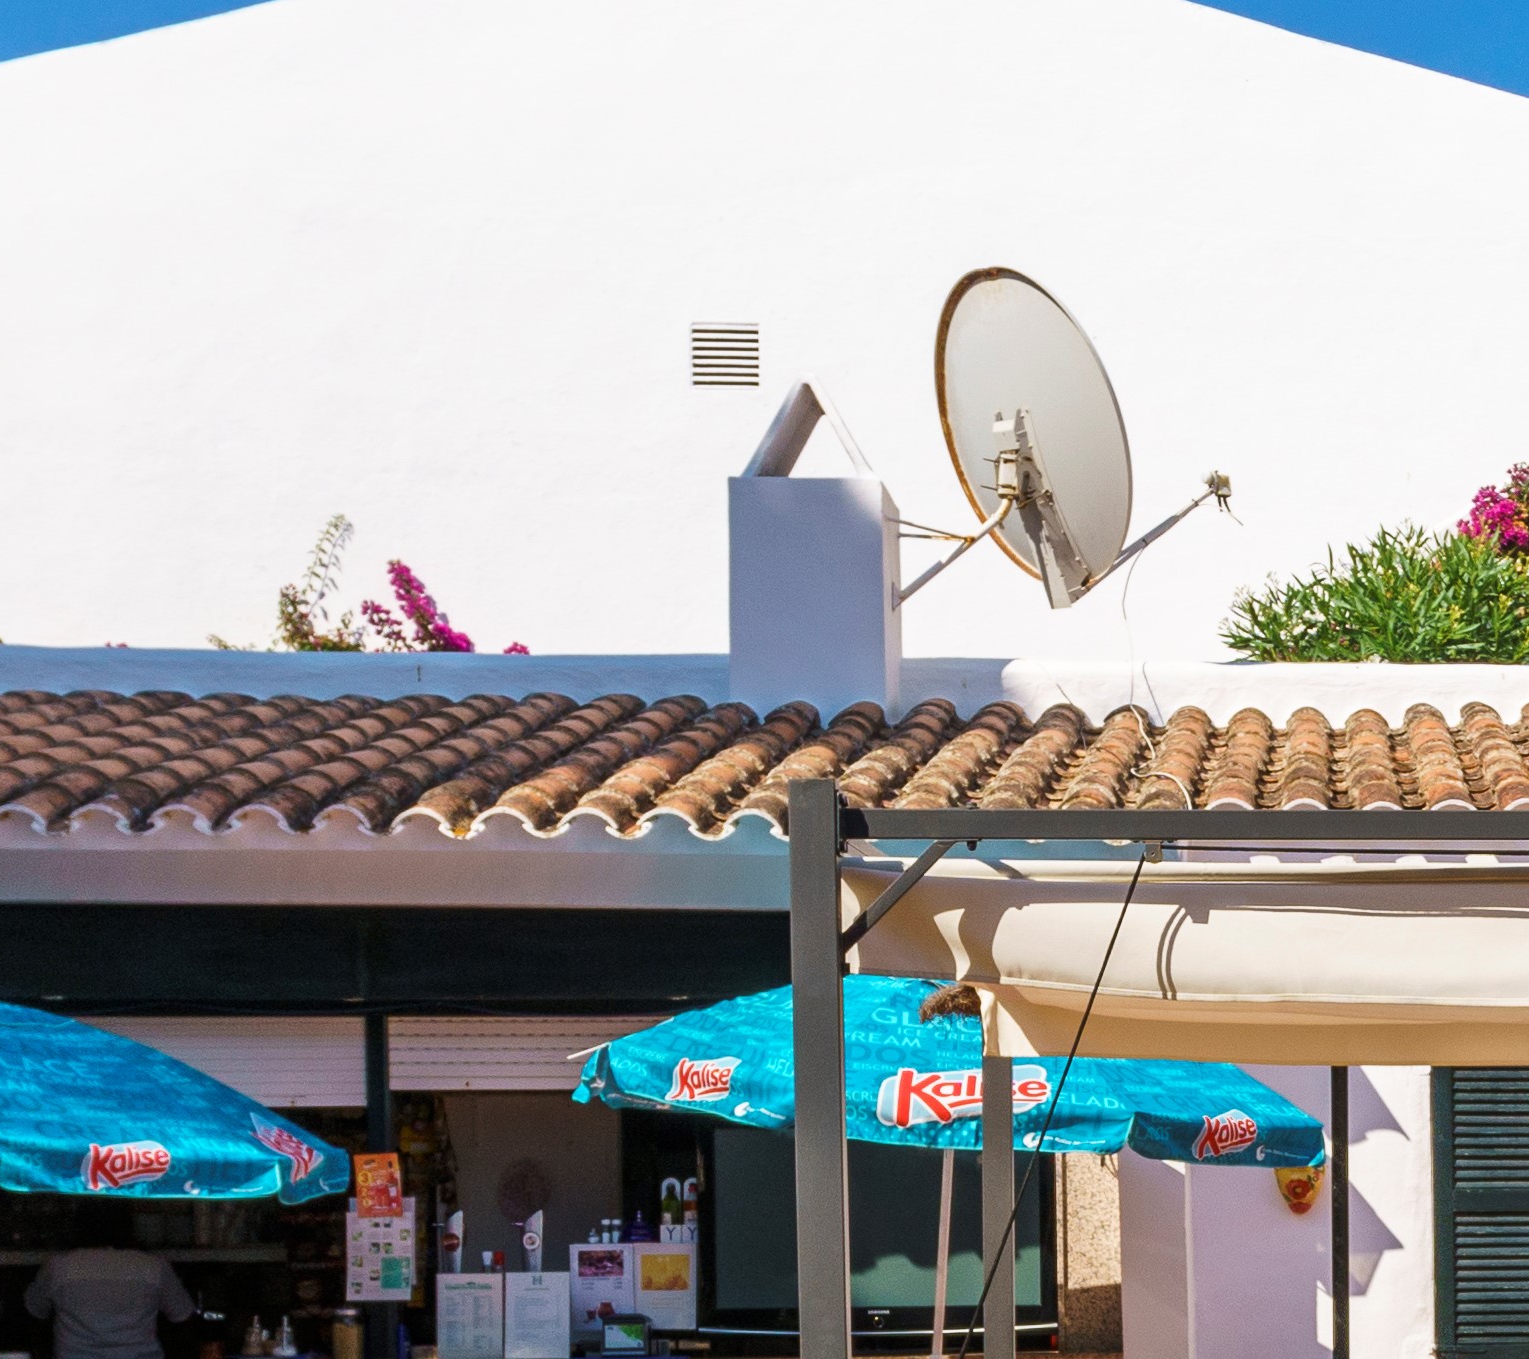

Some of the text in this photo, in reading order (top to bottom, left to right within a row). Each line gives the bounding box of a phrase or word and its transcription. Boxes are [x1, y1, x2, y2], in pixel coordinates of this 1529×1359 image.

[845, 1031, 922, 1049] REAM
[670, 1058, 731, 1100] Kalise
[895, 1069, 1048, 1127] Kale
[1196, 1115, 1257, 1160] Kalise
[89, 1143, 171, 1190] Kalise
